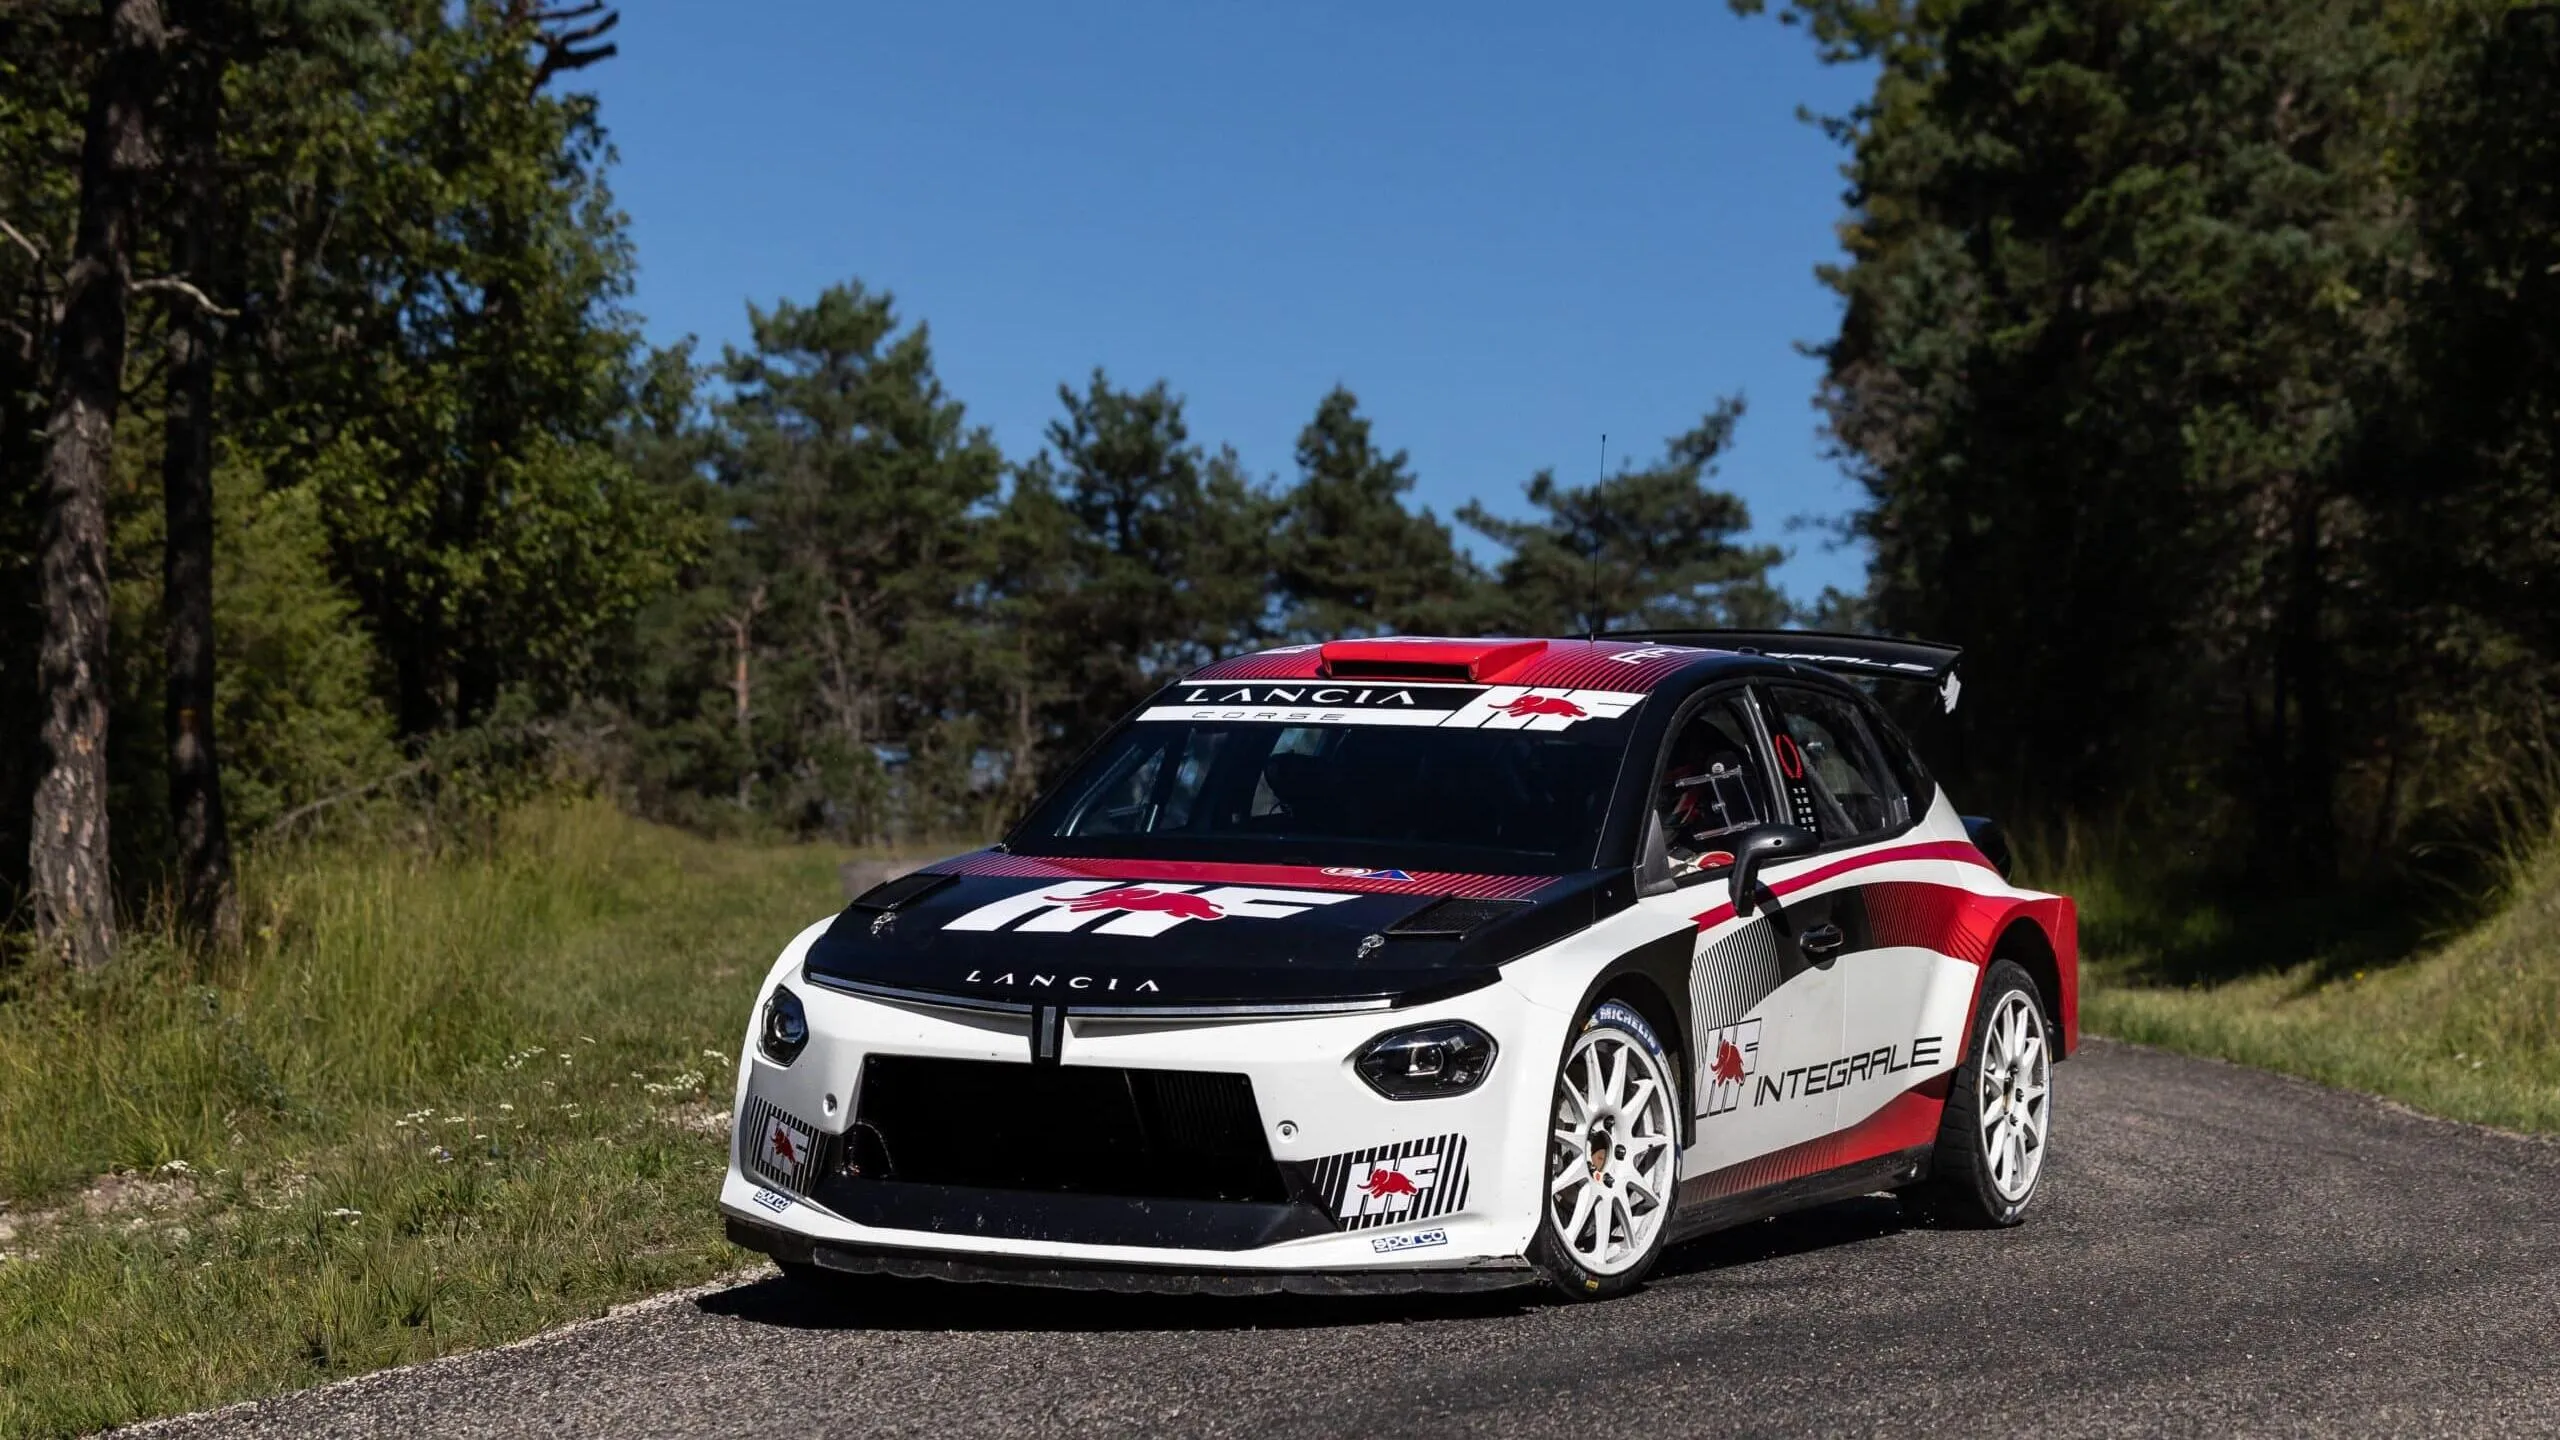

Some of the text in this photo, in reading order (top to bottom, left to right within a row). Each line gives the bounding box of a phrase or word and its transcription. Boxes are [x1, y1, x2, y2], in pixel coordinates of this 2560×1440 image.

[1185, 687, 1416, 706] LANCIA
[1192, 711, 1347, 722] CORSE
[965, 968, 1160, 993] LANCIA
[1598, 1006, 1657, 1050] MICHELIN
[1753, 1036, 1943, 1108] INTEGRALE
[1373, 1229, 1445, 1252] sparco
